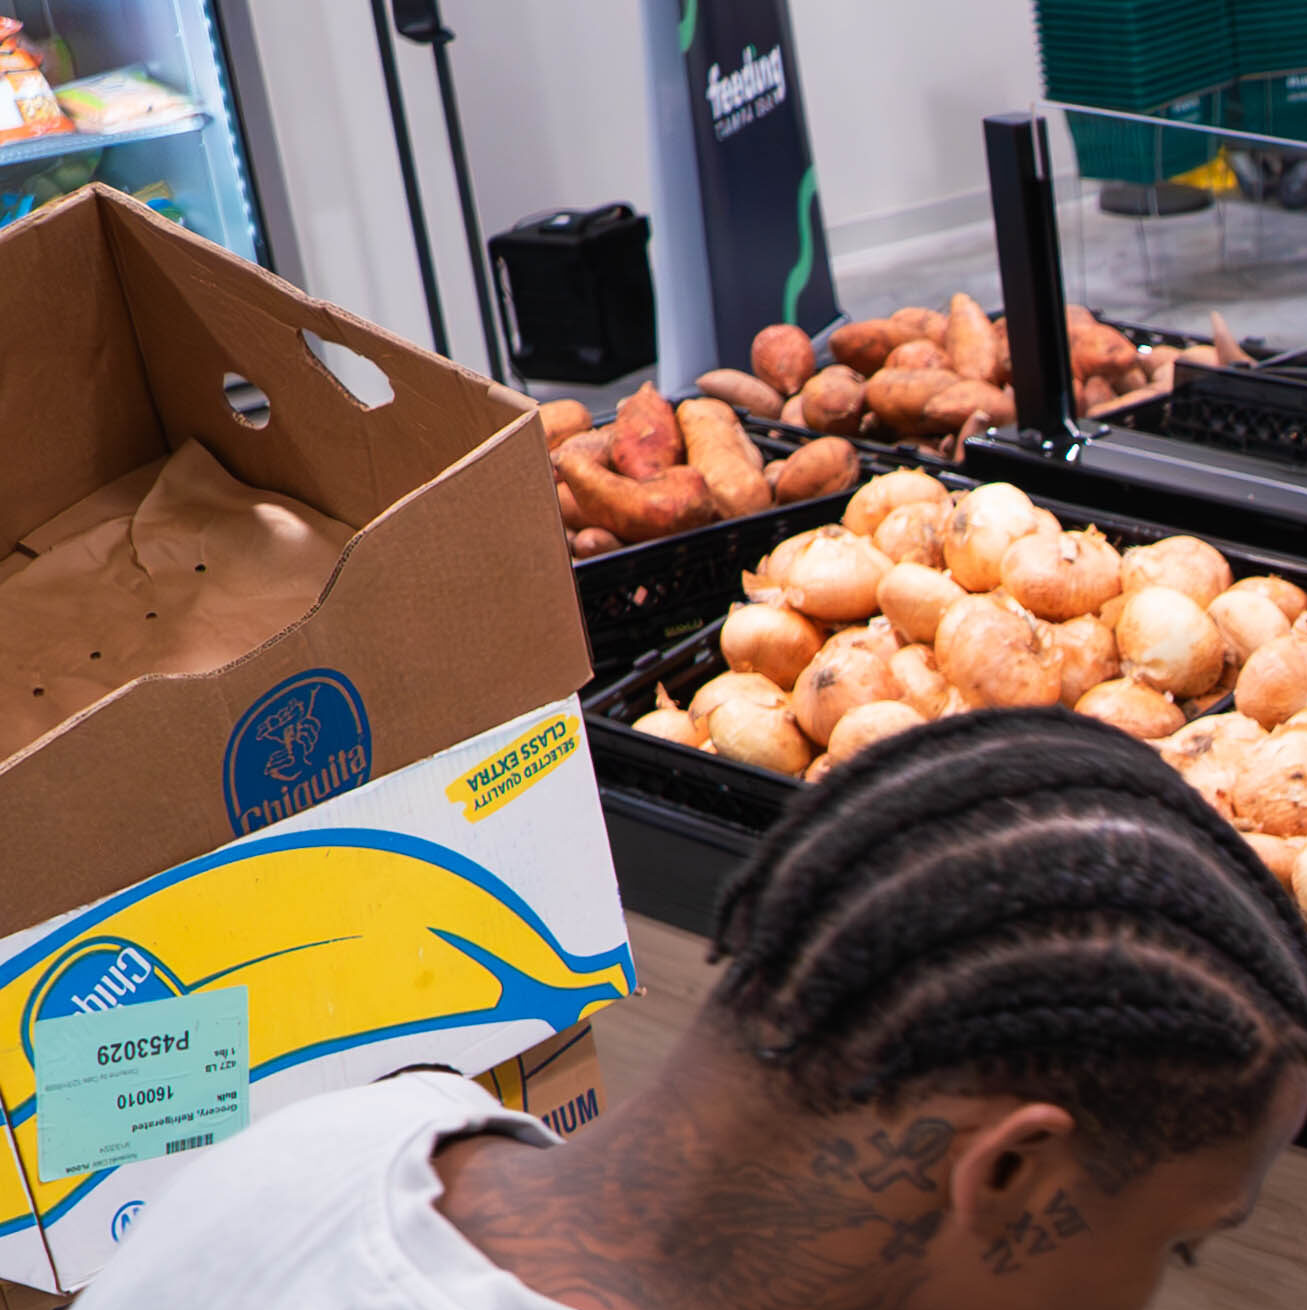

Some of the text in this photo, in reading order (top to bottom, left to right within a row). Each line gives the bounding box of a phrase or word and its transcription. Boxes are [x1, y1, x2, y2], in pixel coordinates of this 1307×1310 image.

[466, 720, 567, 792] CLASS EXTRA
[474, 737, 576, 811] SELECTED QUALITY
[97, 1030, 190, 1066] P453029
[117, 1085, 174, 1110] 160010
